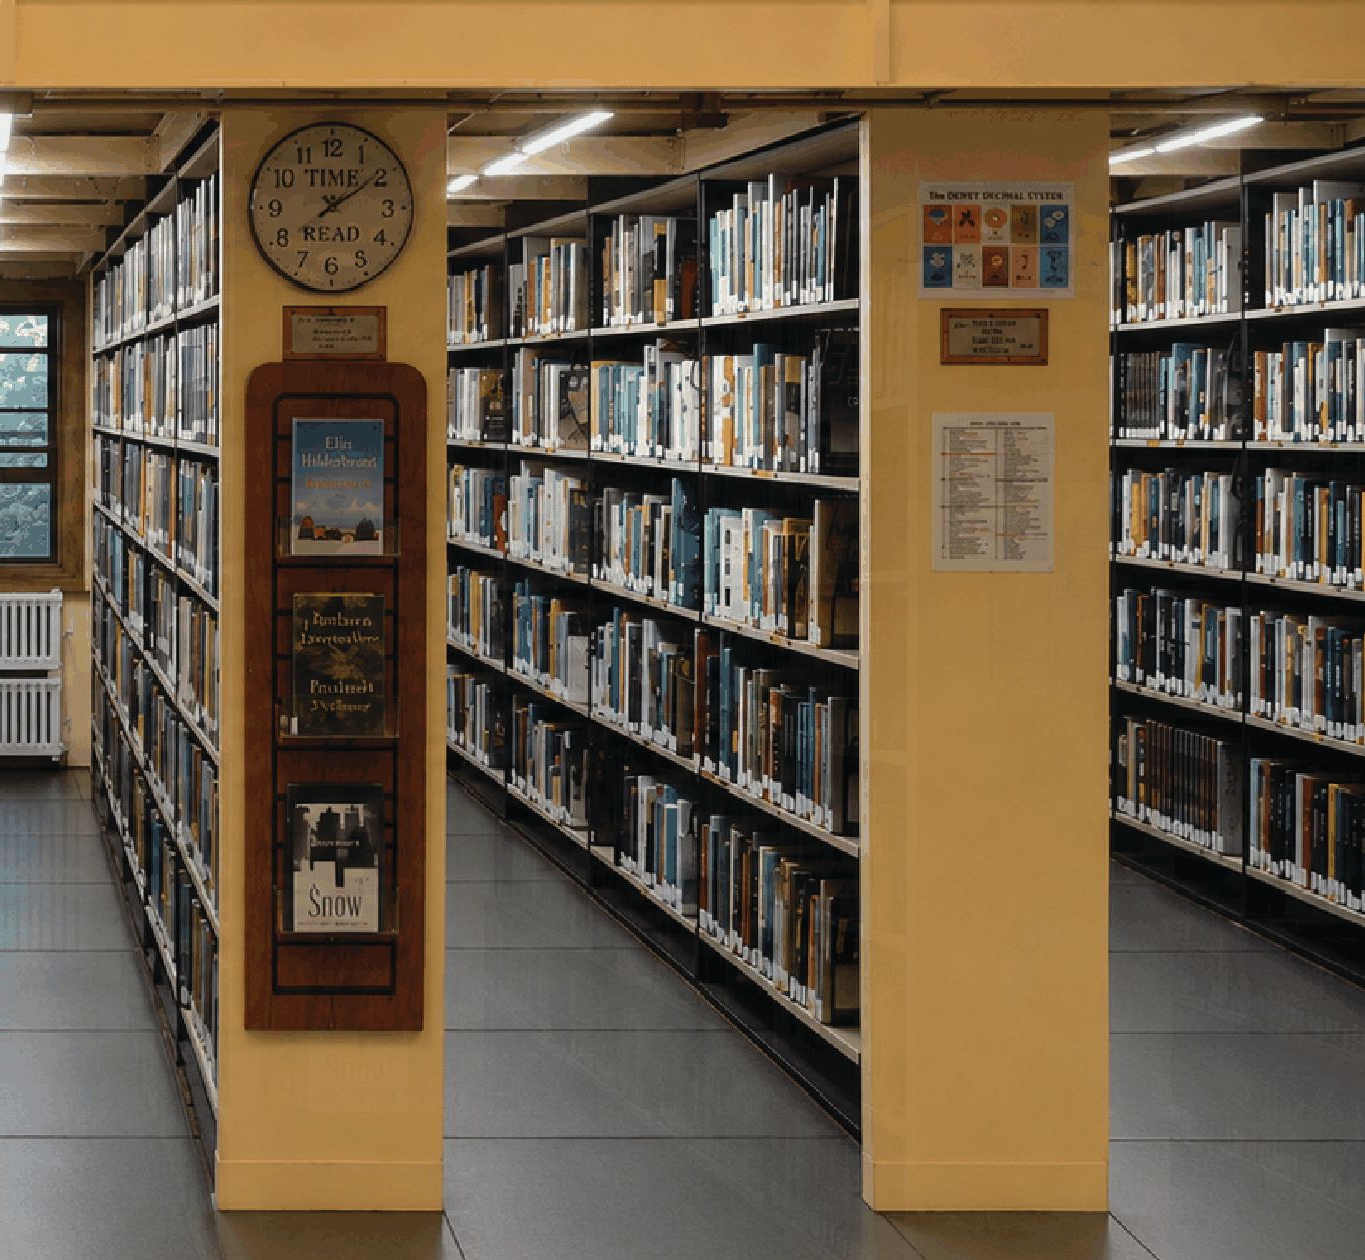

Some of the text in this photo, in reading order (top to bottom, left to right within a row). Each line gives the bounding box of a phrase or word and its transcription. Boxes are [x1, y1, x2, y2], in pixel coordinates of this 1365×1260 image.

[296, 147, 312, 165] 11
[322, 138, 344, 157] 12
[357, 146, 365, 165] 1
[274, 168, 295, 188] 10
[305, 168, 360, 188] TIME
[373, 168, 387, 188] 2
[267, 199, 283, 218] 9
[382, 199, 395, 218] 3
[276, 227, 289, 248] 8
[301, 226, 360, 243] READ
[373, 229, 387, 246] 4
[296, 249, 309, 269] 7
[324, 256, 339, 276] 6
[354, 249, 367, 268] 5
[308, 883, 362, 918] Snow
